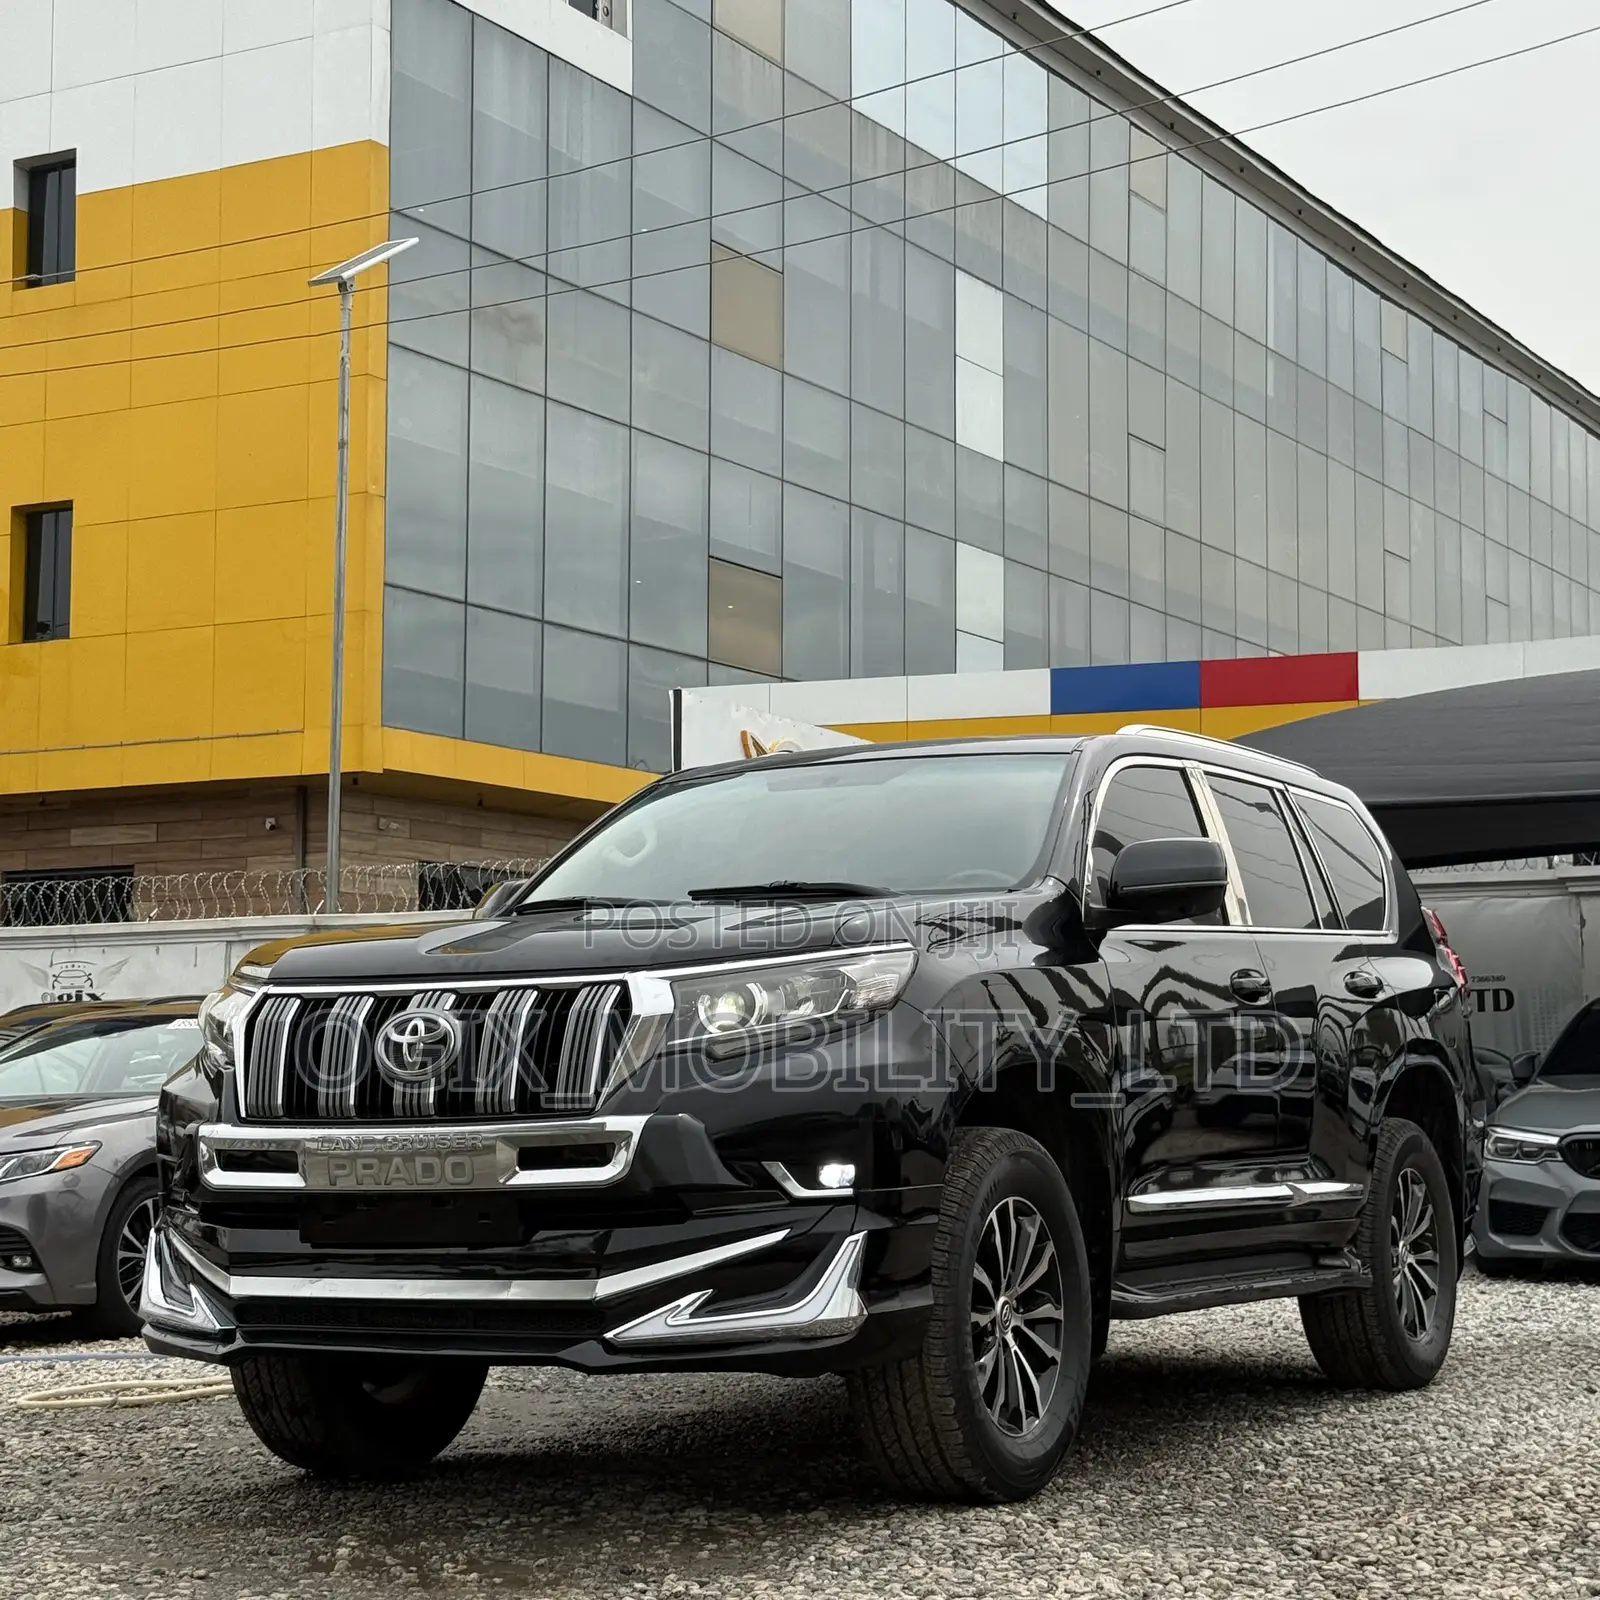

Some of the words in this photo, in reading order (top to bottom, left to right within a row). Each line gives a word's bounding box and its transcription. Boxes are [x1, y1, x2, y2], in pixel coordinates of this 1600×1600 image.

[1469, 988, 1515, 1012] TD
[317, 1136, 376, 1151] LAND
[382, 1133, 483, 1150] CRUISER
[328, 1155, 474, 1186] PRADO
